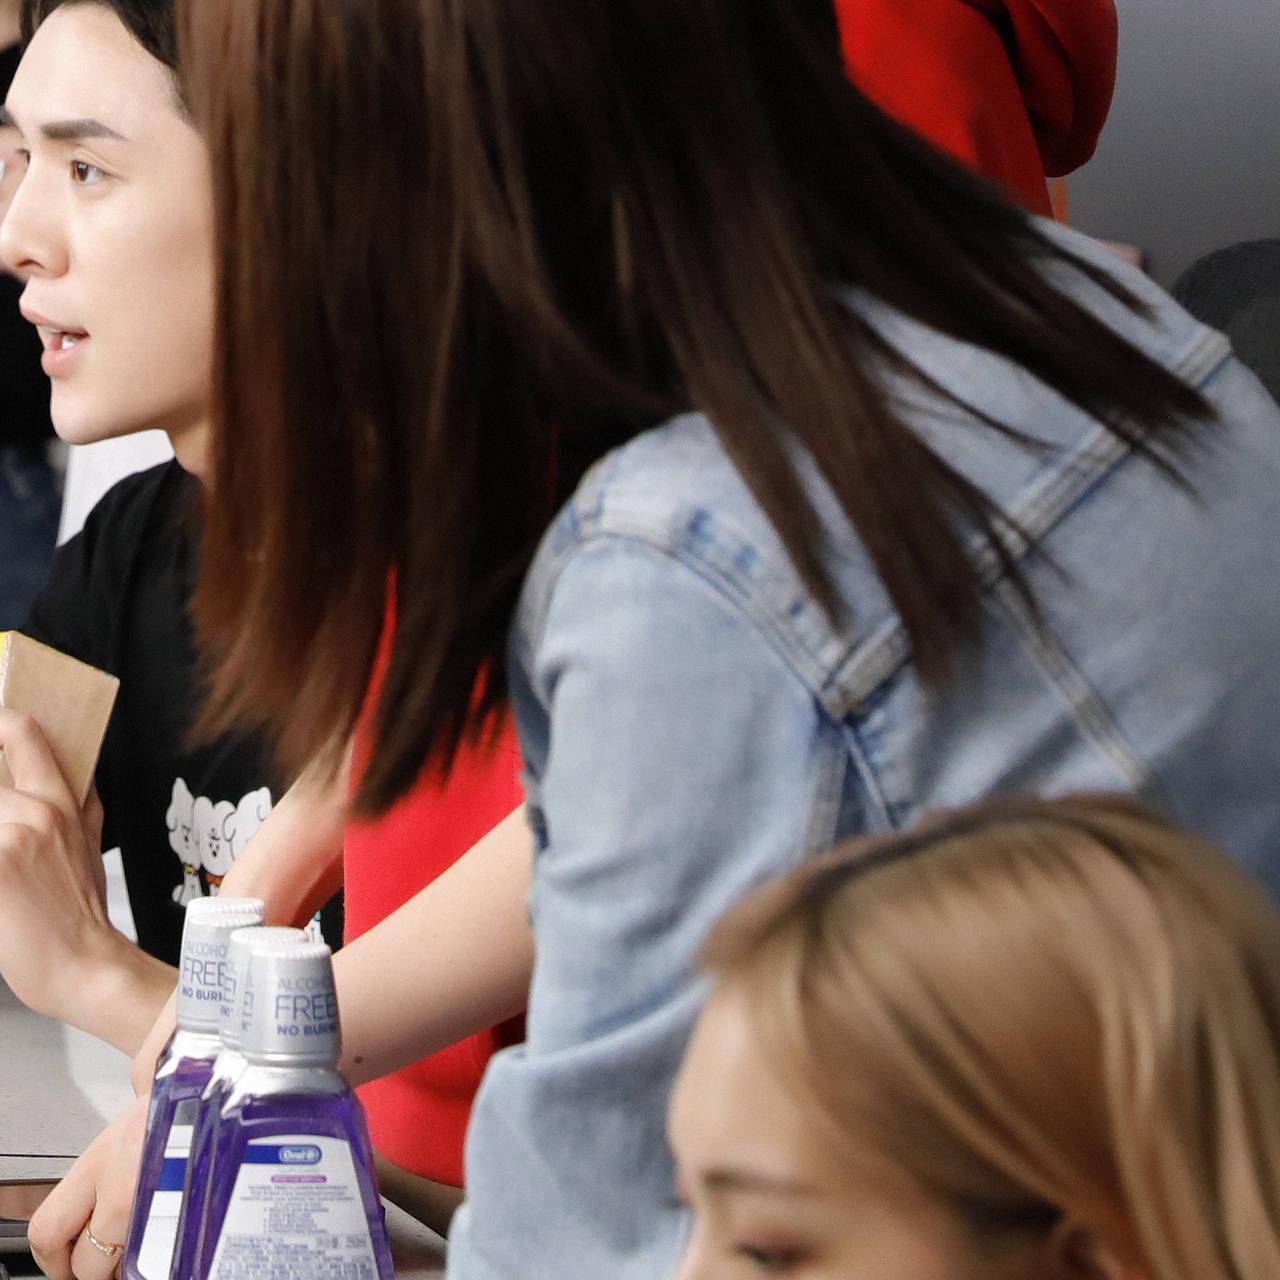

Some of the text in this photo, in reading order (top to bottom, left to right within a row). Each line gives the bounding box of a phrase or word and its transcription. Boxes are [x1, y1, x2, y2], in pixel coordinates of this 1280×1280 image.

[186, 941, 228, 958] ALCOHO
[182, 956, 227, 987] FREE
[275, 993, 336, 1020] FREE
[277, 1025, 299, 1036] NO
